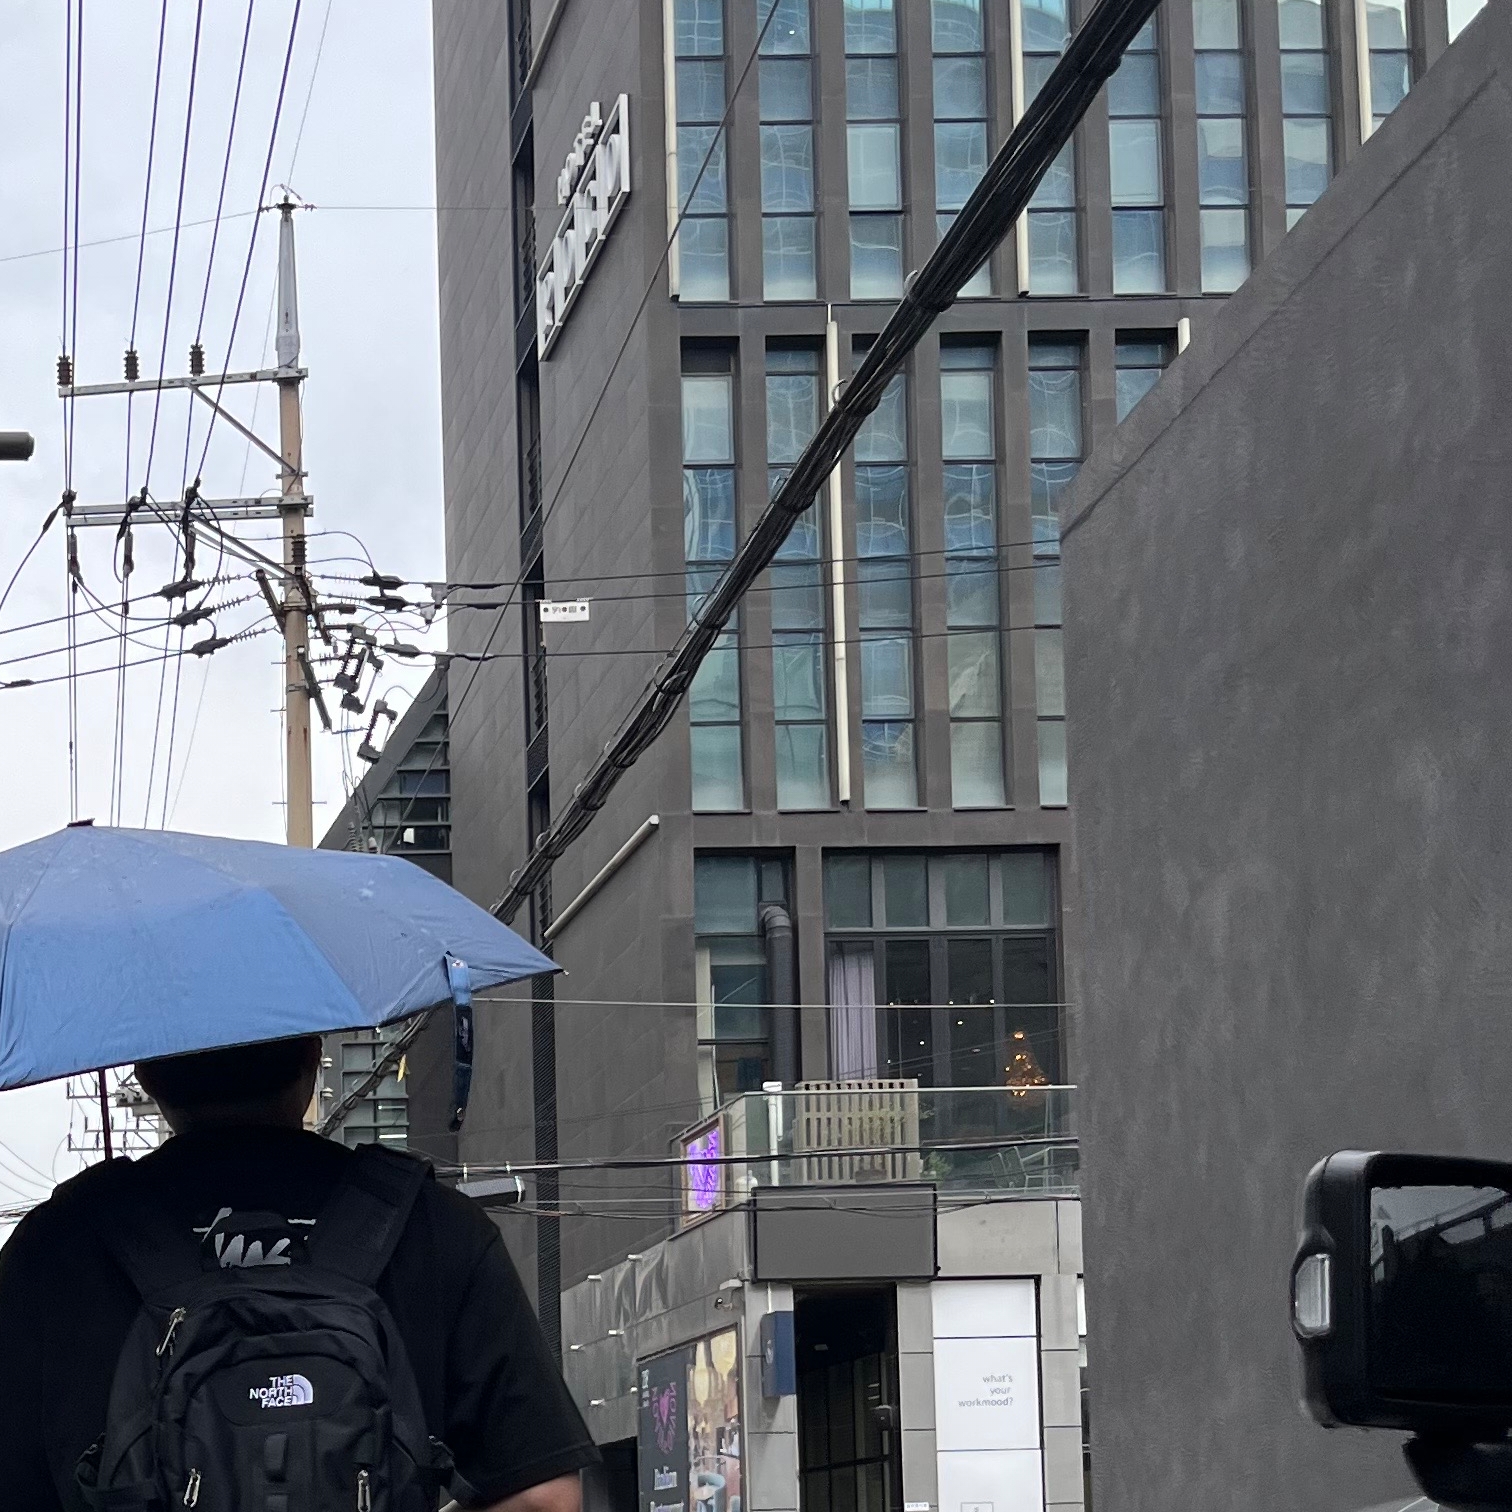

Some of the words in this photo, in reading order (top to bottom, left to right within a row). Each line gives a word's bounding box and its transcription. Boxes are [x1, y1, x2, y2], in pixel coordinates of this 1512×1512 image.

[269, 1374, 294, 1388] THE
[982, 1373, 1014, 1384] what's
[249, 1387, 293, 1400] NORTH
[989, 1386, 1012, 1397] your
[261, 1396, 292, 1409] FACE
[958, 1396, 1014, 1408] workmood?
